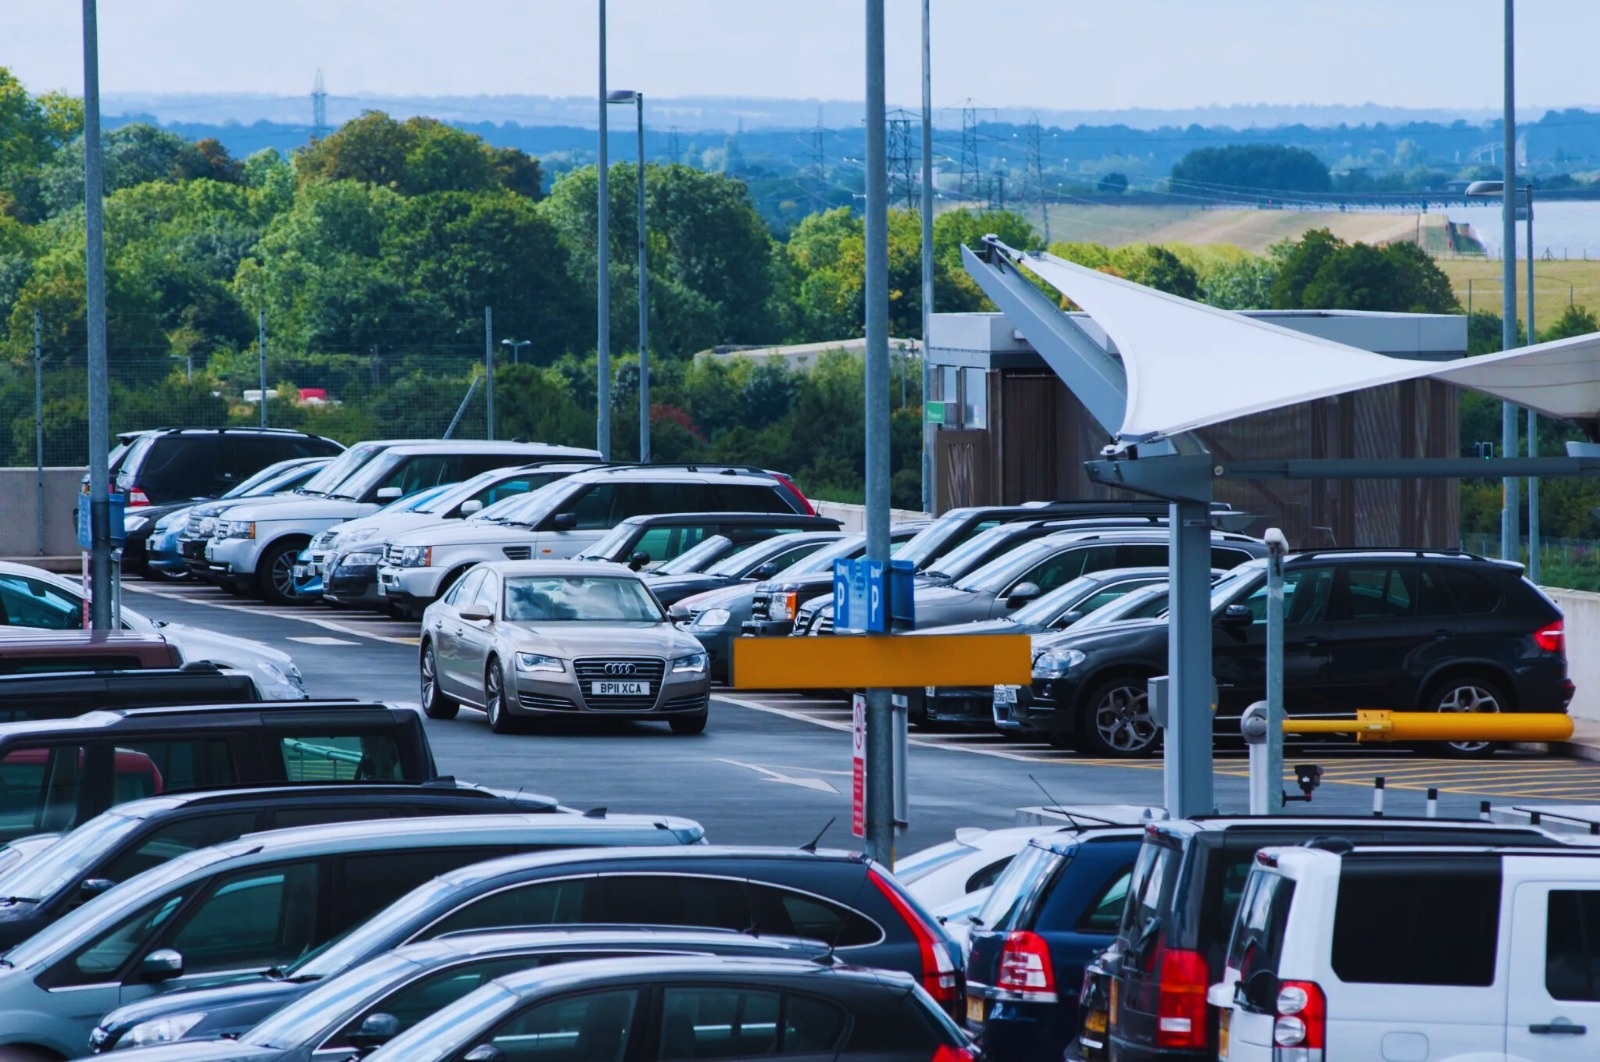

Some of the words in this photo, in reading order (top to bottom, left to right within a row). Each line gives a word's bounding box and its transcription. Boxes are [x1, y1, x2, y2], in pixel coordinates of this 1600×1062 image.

[837, 581, 845, 620] P
[871, 584, 879, 623] P
[600, 681, 620, 694] BP11
[621, 681, 642, 694] XCA
